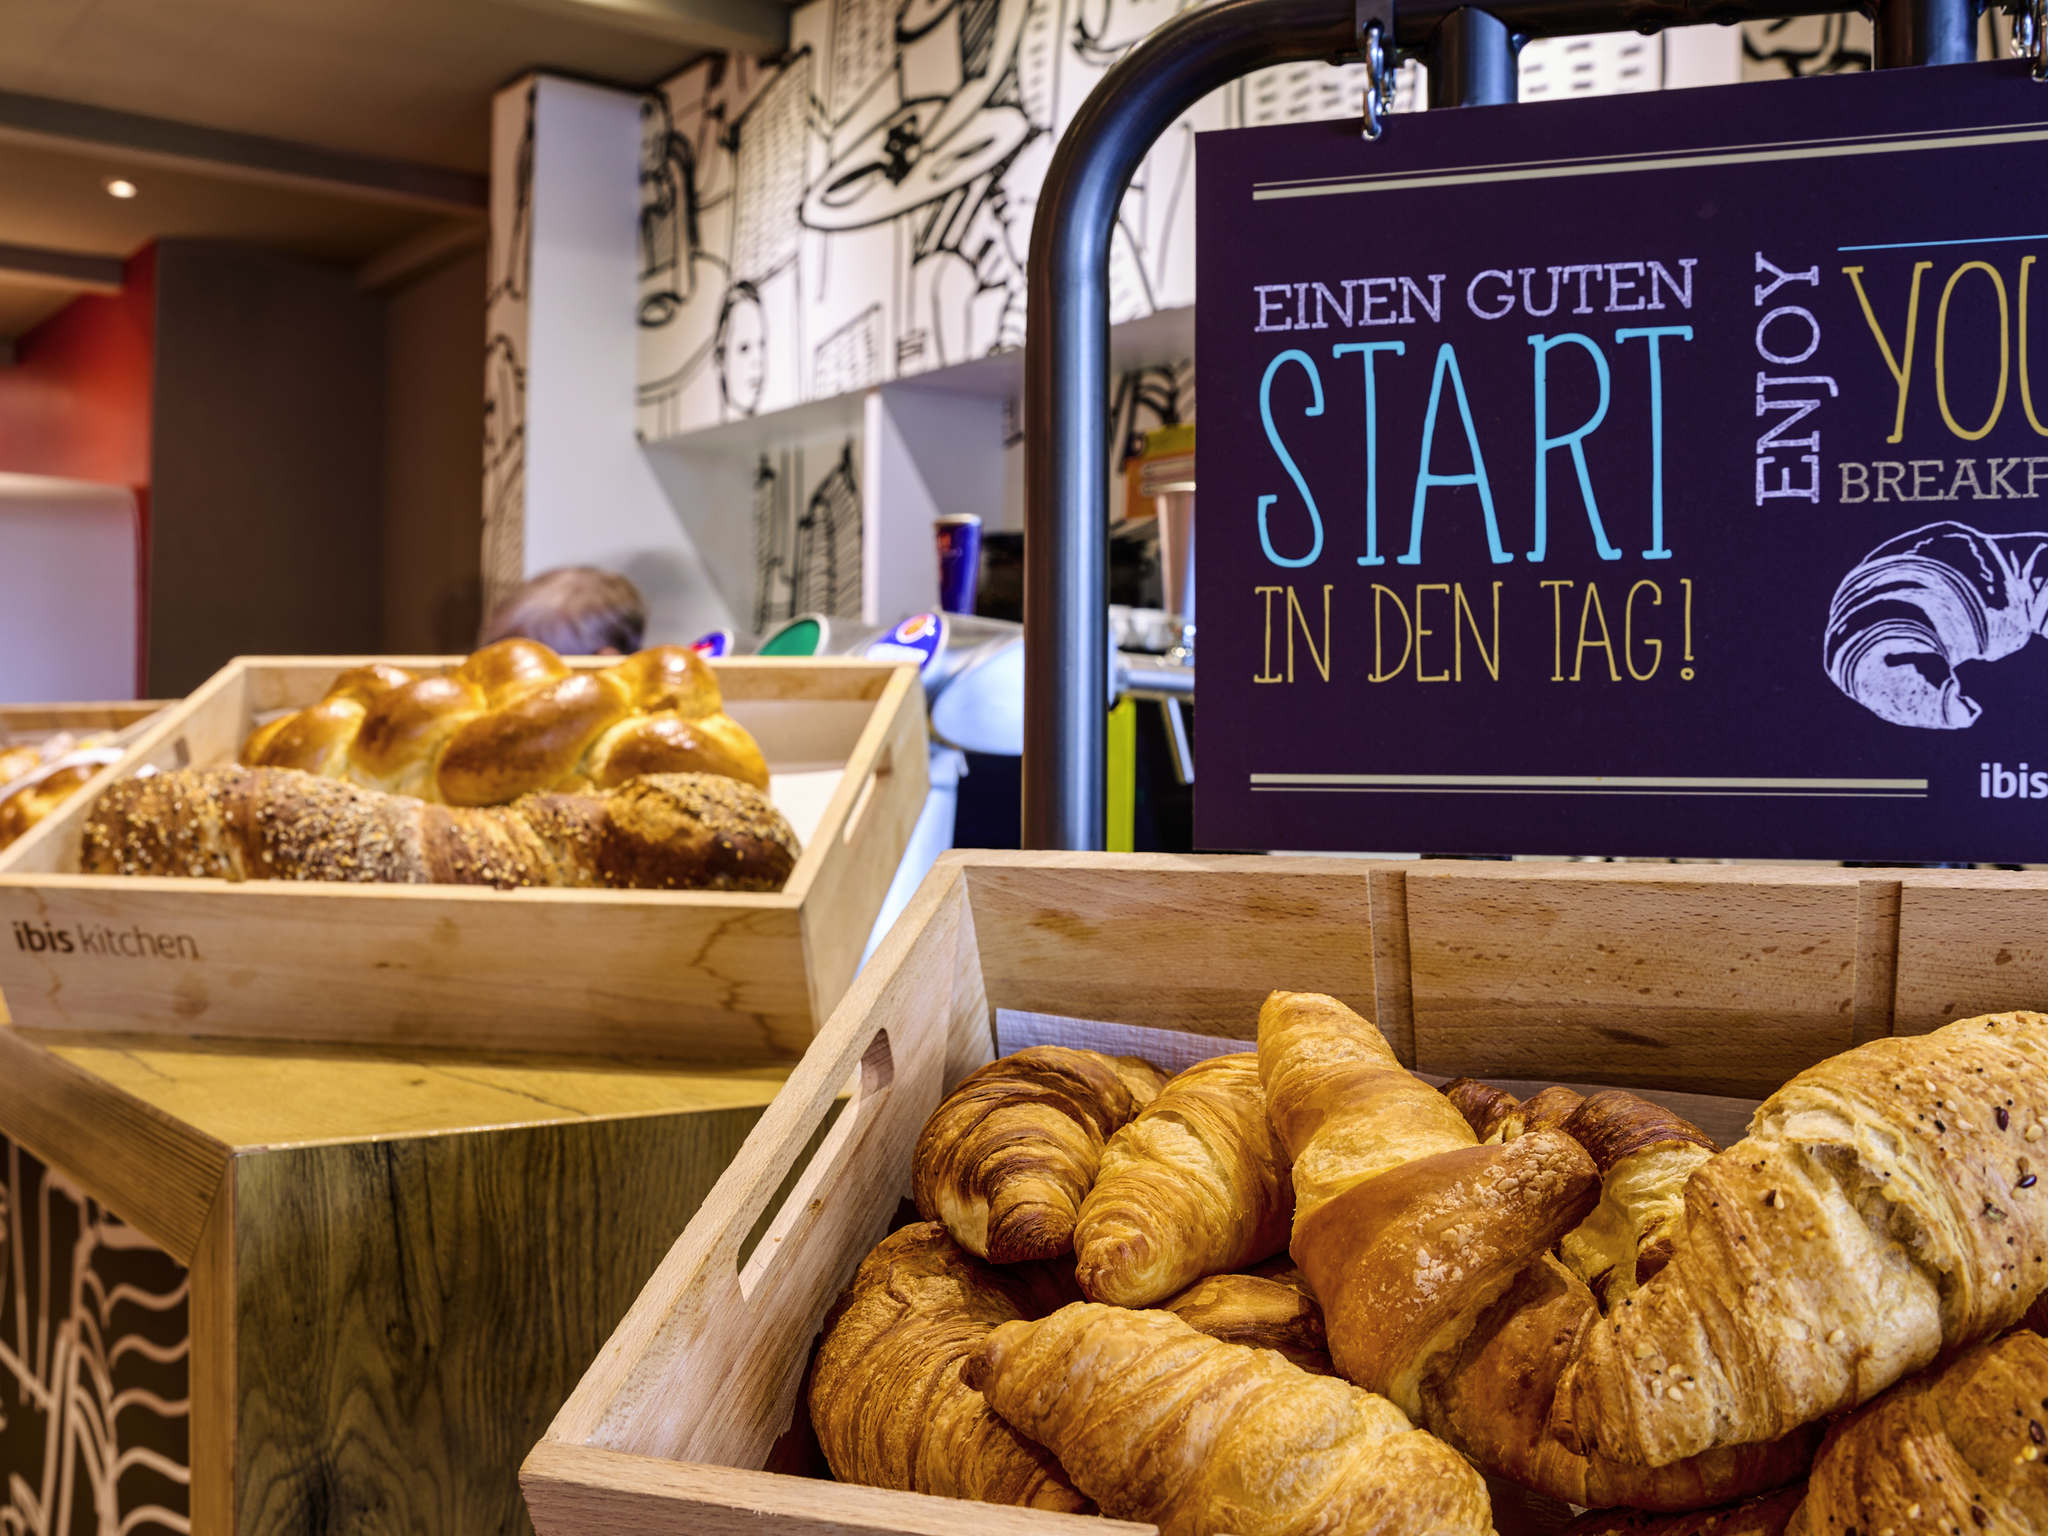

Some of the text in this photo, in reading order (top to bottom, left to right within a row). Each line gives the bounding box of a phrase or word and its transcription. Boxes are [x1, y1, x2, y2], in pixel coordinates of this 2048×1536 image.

[1254, 258, 1698, 332] EINEN GUTEN
[1754, 251, 1839, 506] ENJOY
[1257, 324, 1693, 568] START
[1254, 579, 1694, 683] IN DEN TAG!
[1981, 763, 2048, 799] ibis
[13, 921, 200, 961] ibis kitchen
